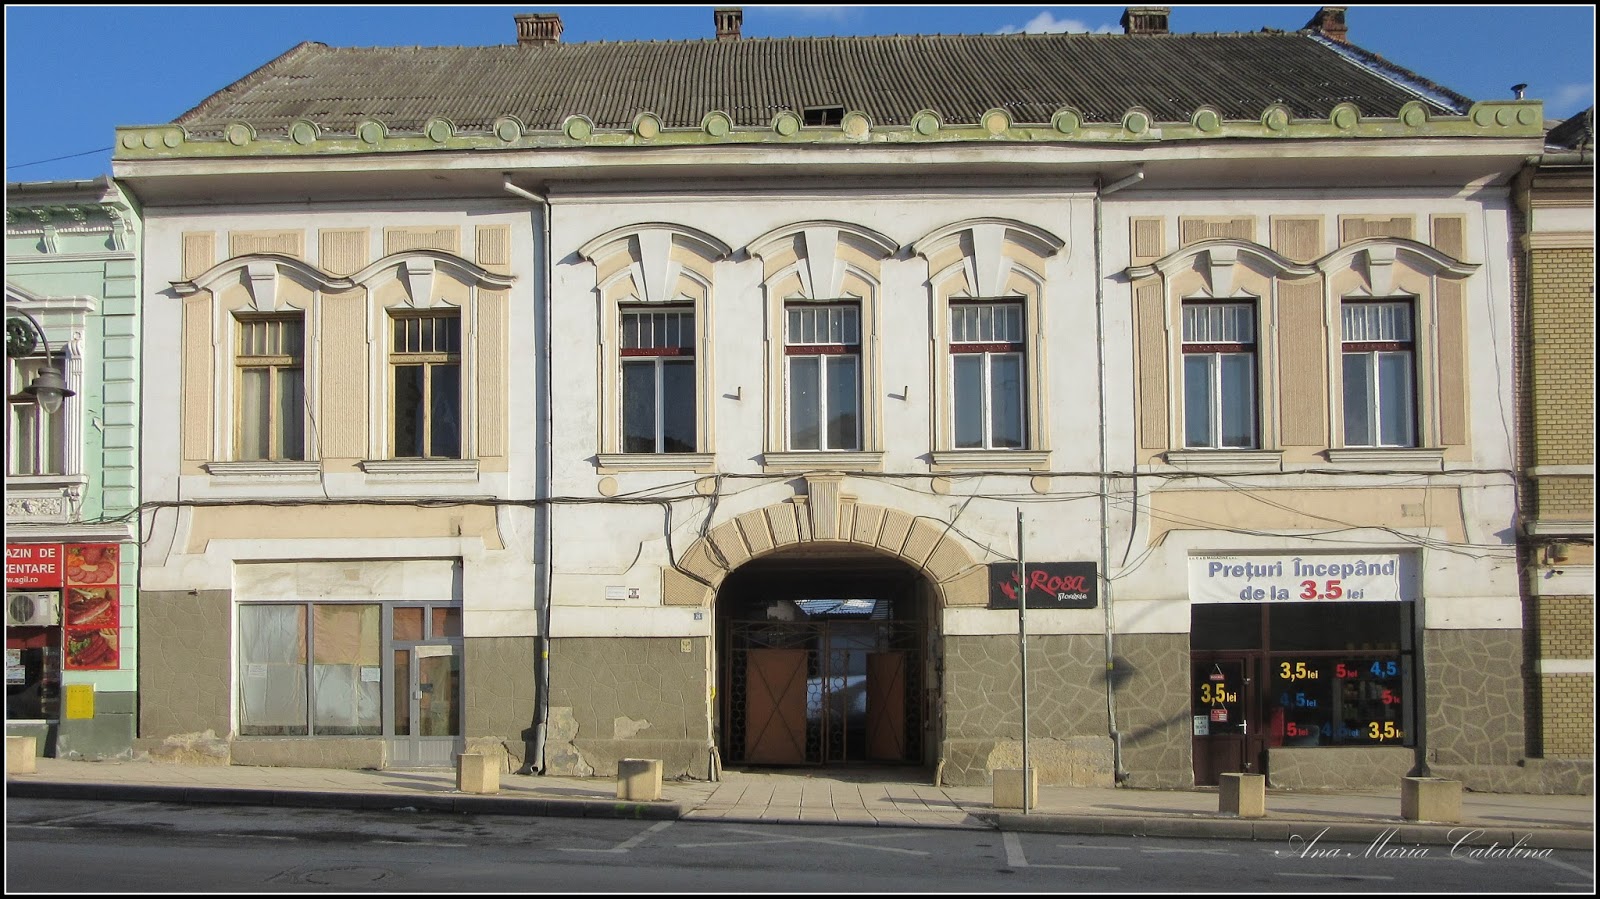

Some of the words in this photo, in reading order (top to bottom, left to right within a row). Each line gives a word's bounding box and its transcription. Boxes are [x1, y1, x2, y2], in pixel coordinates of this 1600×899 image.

[39, 548, 56, 558] DE
[1291, 557, 1395, 580] Începând
[1030, 570, 1090, 598] Rosa
[1239, 586, 1265, 601] de
[1270, 585, 1290, 600] la
[1300, 579, 1343, 600] 3.5
[1347, 588, 1364, 600] lei
[1280, 662, 1307, 682] 3,5
[1307, 670, 1319, 679] lei
[1336, 664, 1347, 678] 5
[1370, 661, 1397, 679] 4,5
[1201, 683, 1226, 707] 3,5
[1226, 692, 1237, 703] lei
[1306, 699, 1317, 707] lei
[1382, 690, 1393, 705] 5
[1287, 722, 1297, 737] 5
[1368, 721, 1395, 741] 3,5
